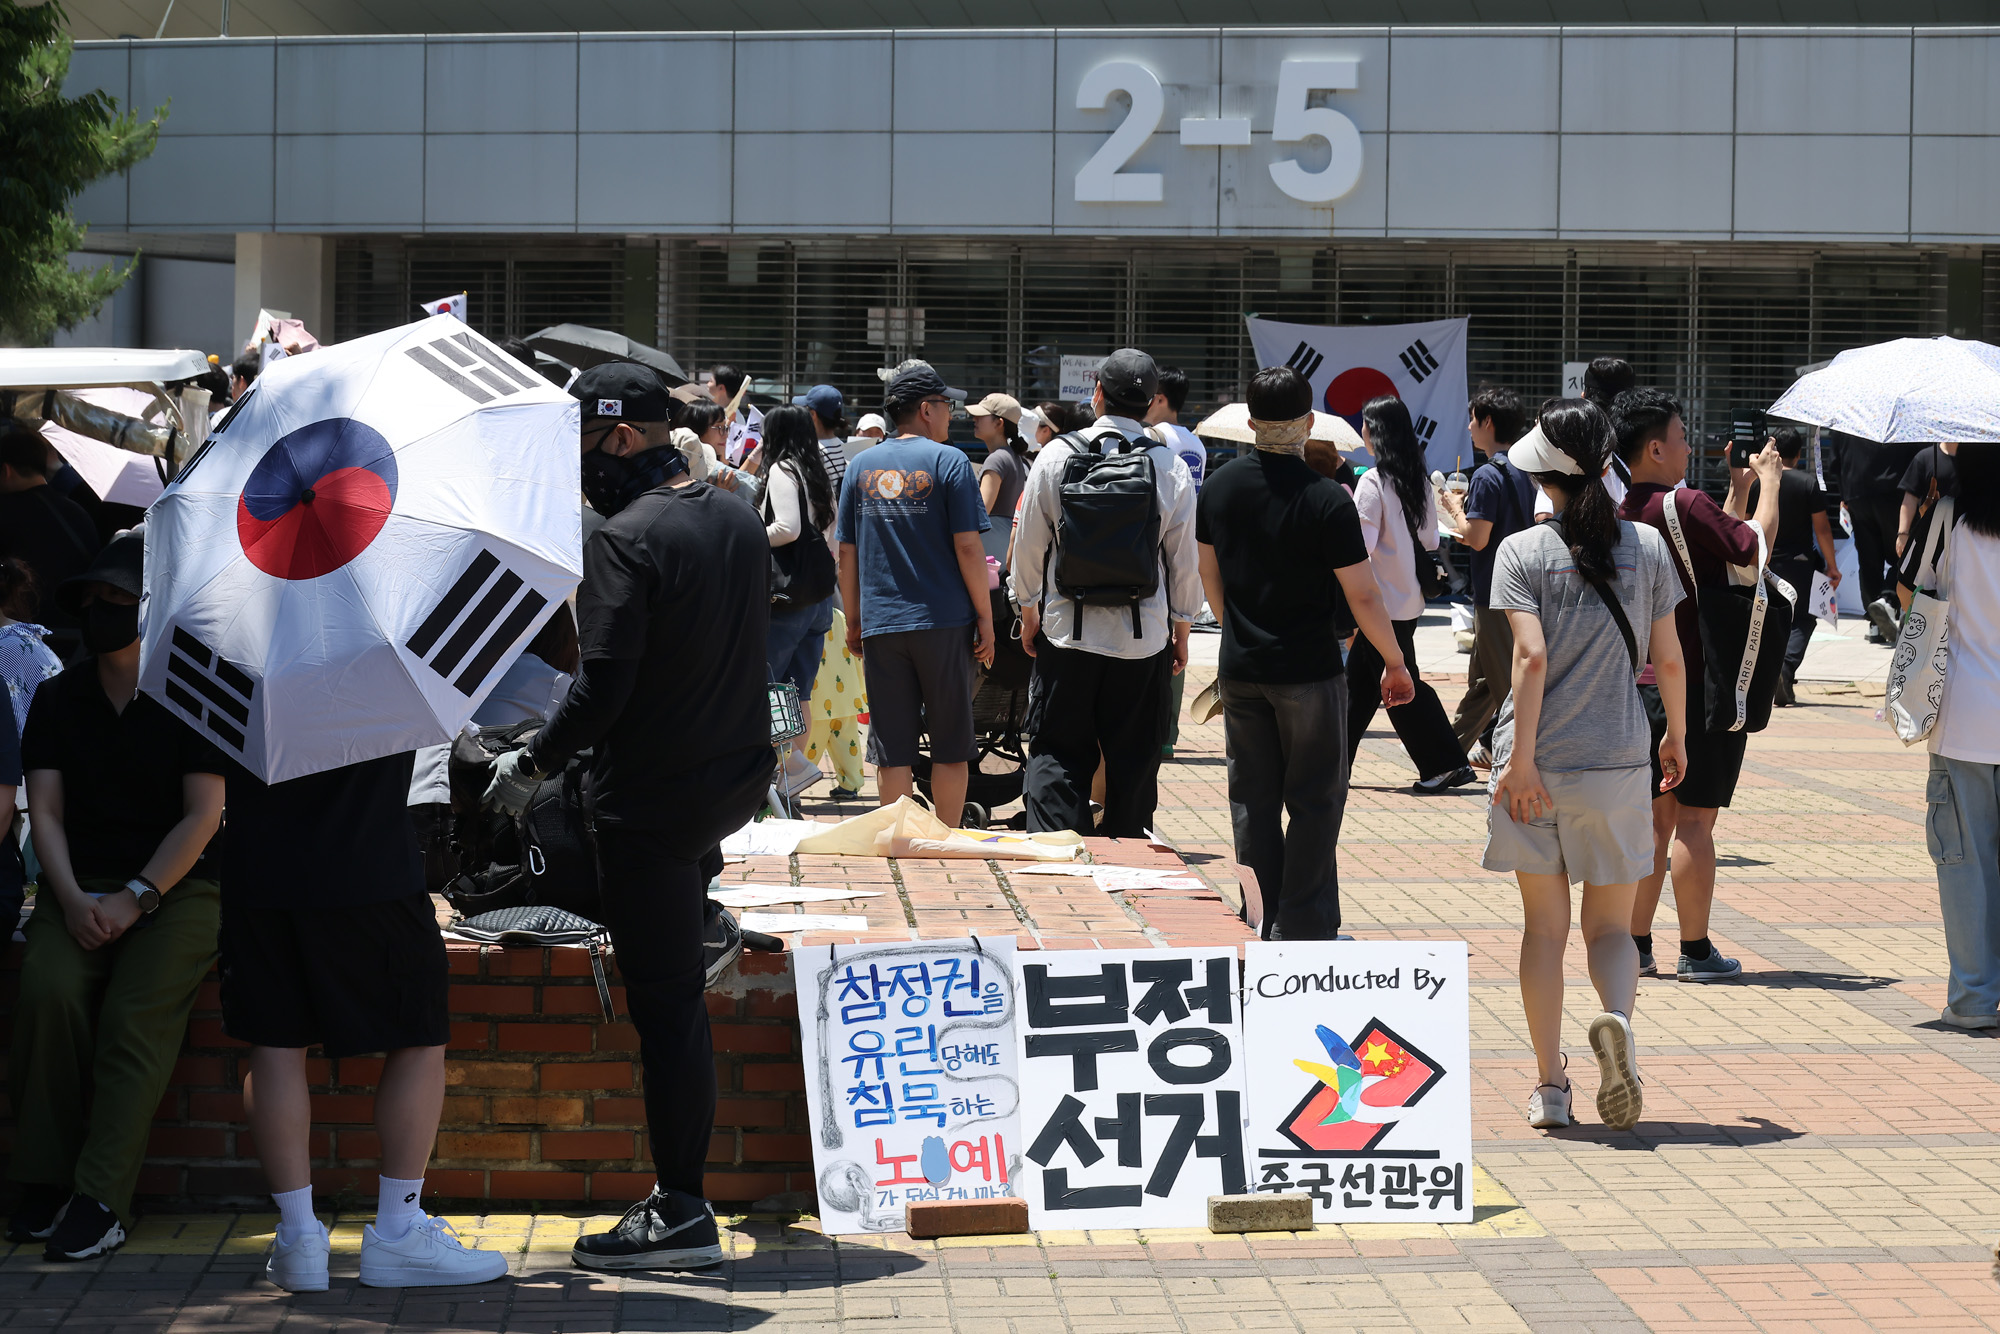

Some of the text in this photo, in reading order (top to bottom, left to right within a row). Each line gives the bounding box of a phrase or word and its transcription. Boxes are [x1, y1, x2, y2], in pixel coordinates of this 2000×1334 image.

[1074, 60, 1364, 202] 2-5
[1668, 518, 1685, 551] PARIS
[1738, 659, 1752, 692] PARIS
[1748, 619, 1761, 652] PARIS
[835, 958, 1004, 1025] 참정권을
[1256, 965, 1447, 1000] Conducted By
[1022, 957, 1233, 1092] 부정
[1025, 1090, 1247, 1210] 선거
